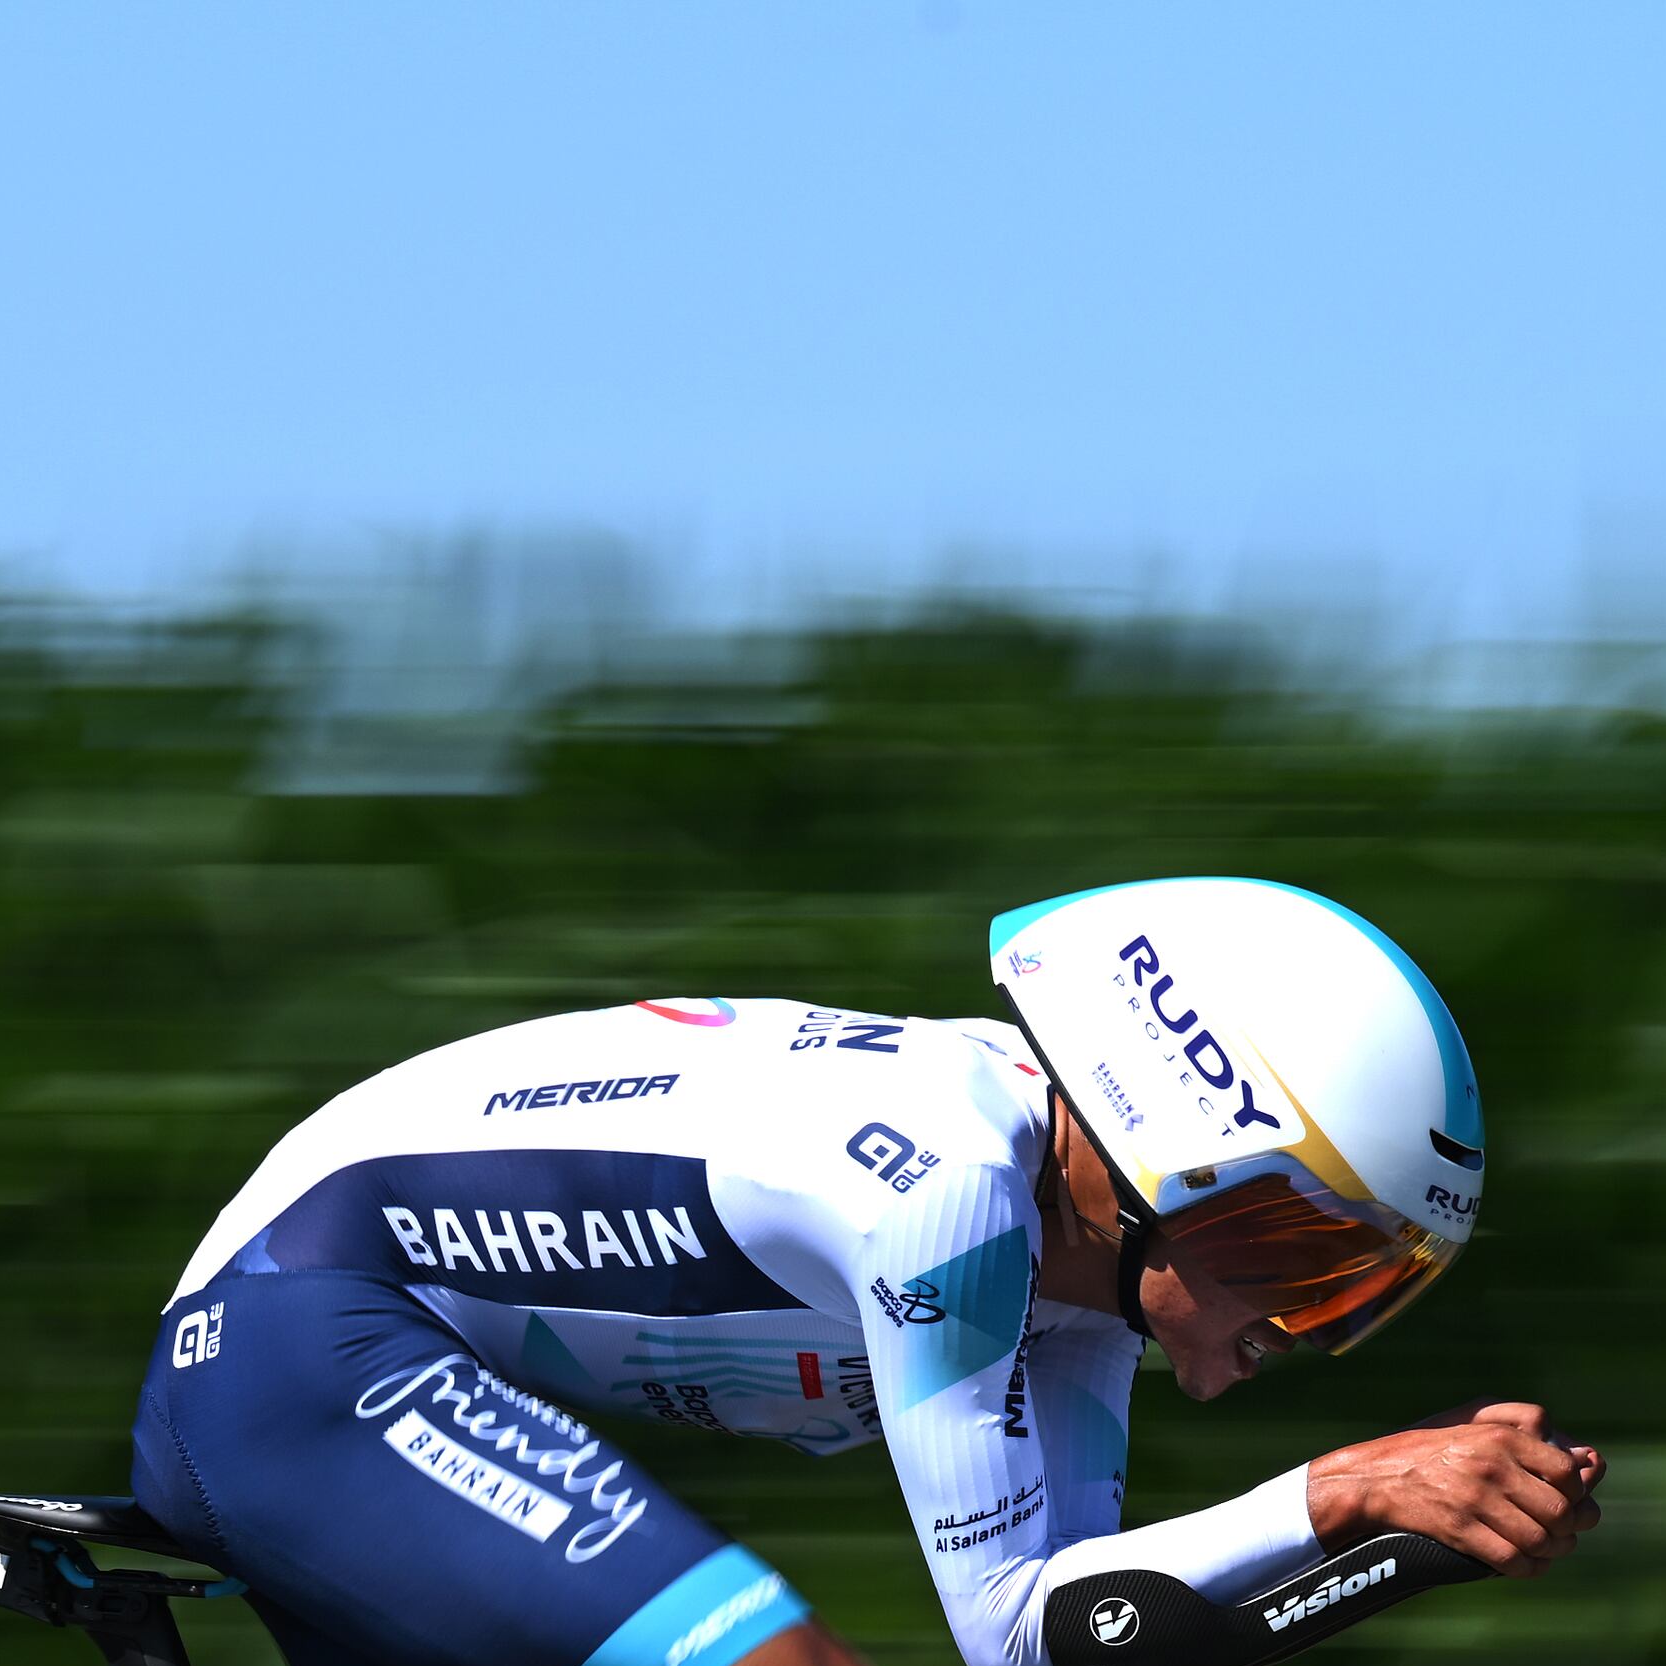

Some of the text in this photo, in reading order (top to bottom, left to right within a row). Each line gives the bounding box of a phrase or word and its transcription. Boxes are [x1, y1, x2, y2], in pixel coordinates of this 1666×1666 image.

[1112, 973, 1235, 1137] PROJECT
[1119, 934, 1281, 1130] RUDY
[483, 1073, 681, 1116] MERIDA
[381, 1206, 707, 1272] BAHRAIN
[1429, 1208, 1476, 1225] PROJ
[870, 1284, 904, 1328] energies
[875, 1276, 903, 1311] Bapco
[936, 1494, 1044, 1552] Al Salam Bank
[1262, 1557, 1397, 1633] Vision
